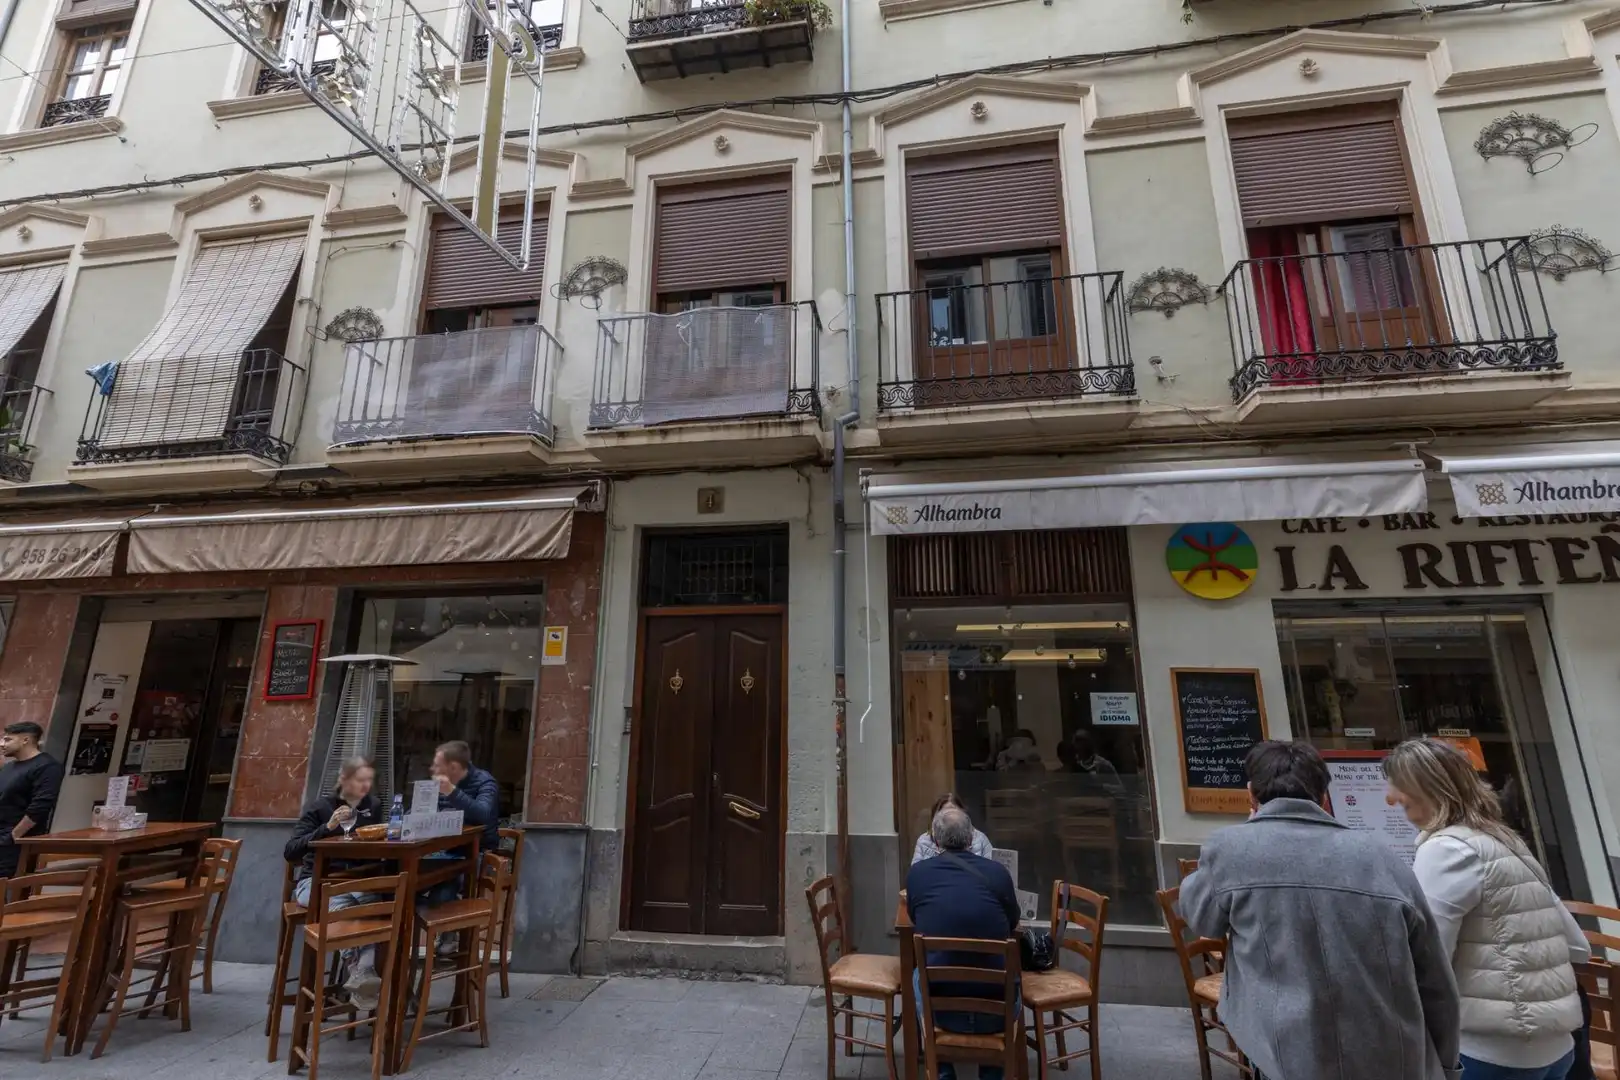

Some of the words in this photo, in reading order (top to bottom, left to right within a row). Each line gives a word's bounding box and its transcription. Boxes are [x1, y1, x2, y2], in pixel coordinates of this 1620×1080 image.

[1513, 478, 1620, 504] Alhambr
[913, 503, 1002, 524] Alhambra
[1382, 511, 1440, 530] BAR
[21, 548, 47, 564] 958
[48, 547, 69, 563] 26
[1274, 544, 1370, 591] LA
